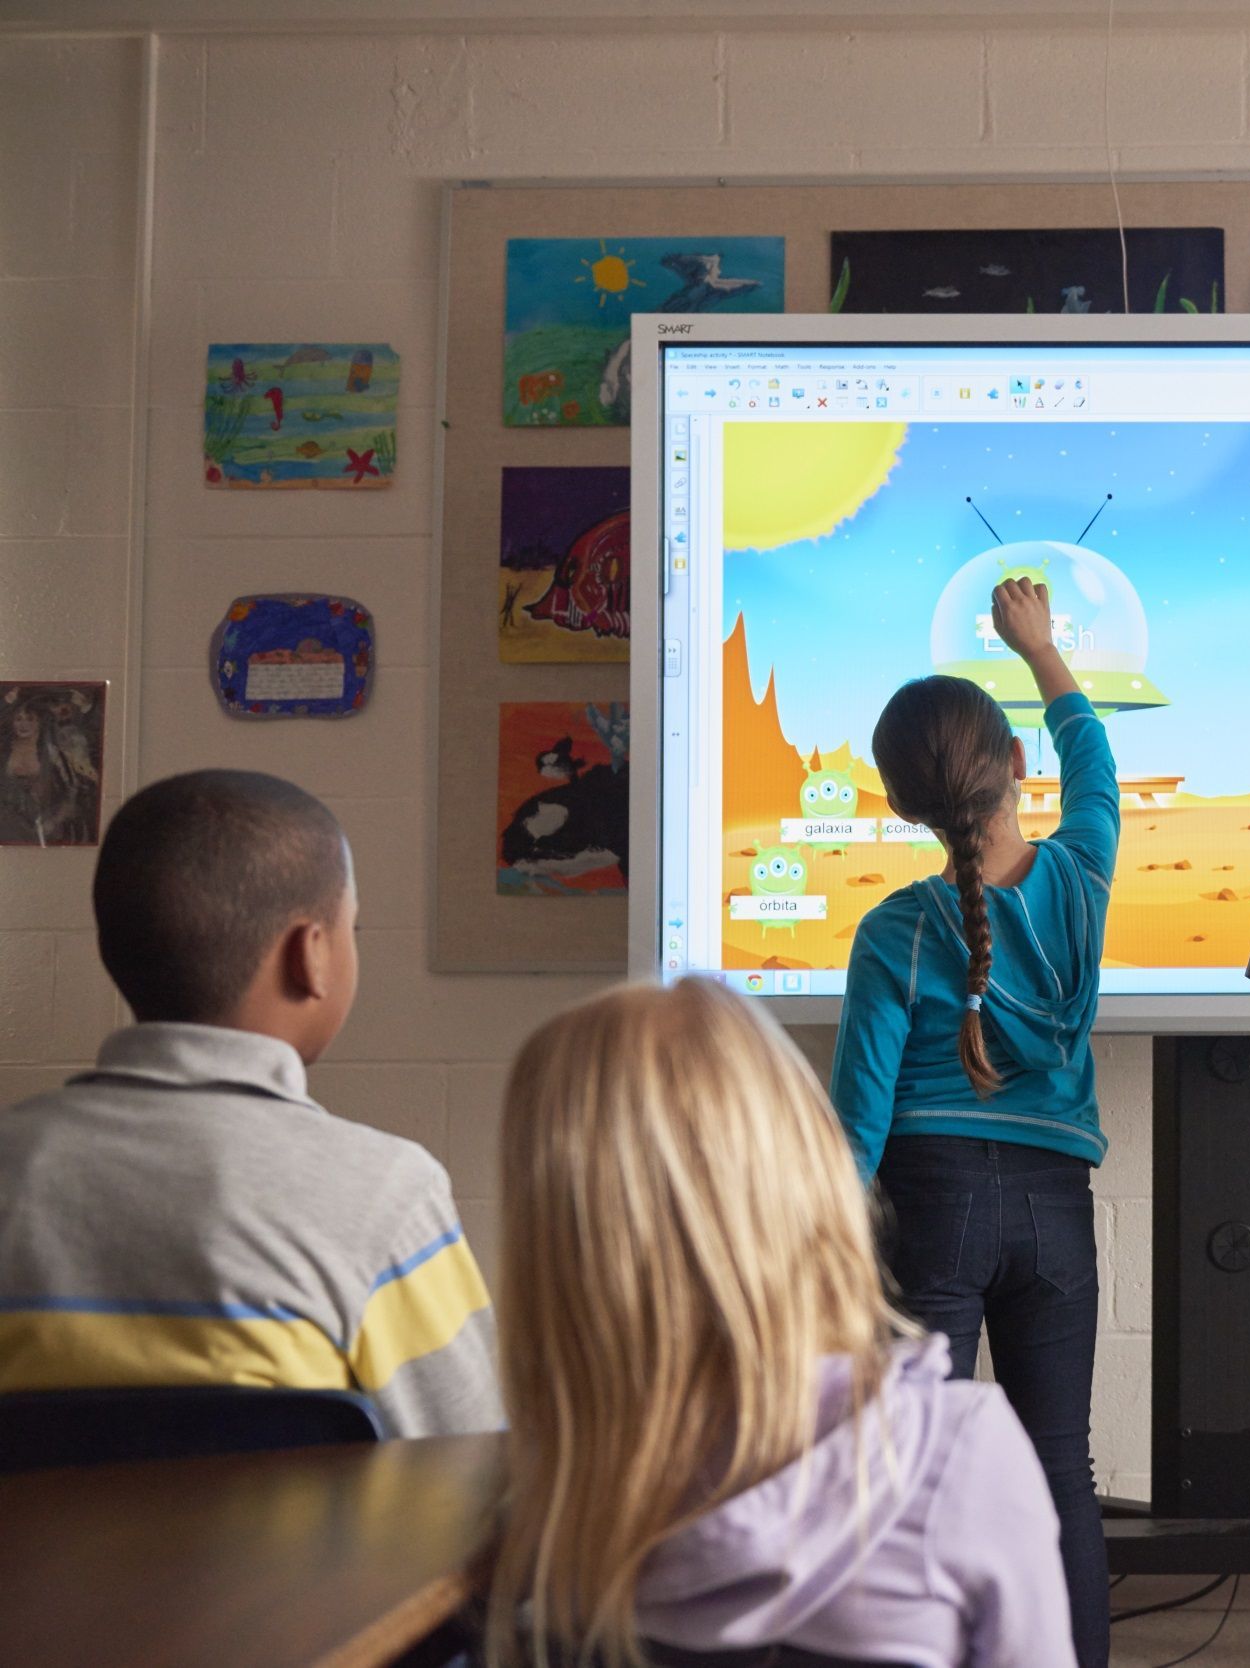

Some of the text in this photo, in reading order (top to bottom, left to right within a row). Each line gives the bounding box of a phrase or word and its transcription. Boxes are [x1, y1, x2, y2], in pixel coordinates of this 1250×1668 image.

[657, 323, 694, 335] SMART
[805, 822, 852, 837] galaxia
[886, 822, 930, 834] conste
